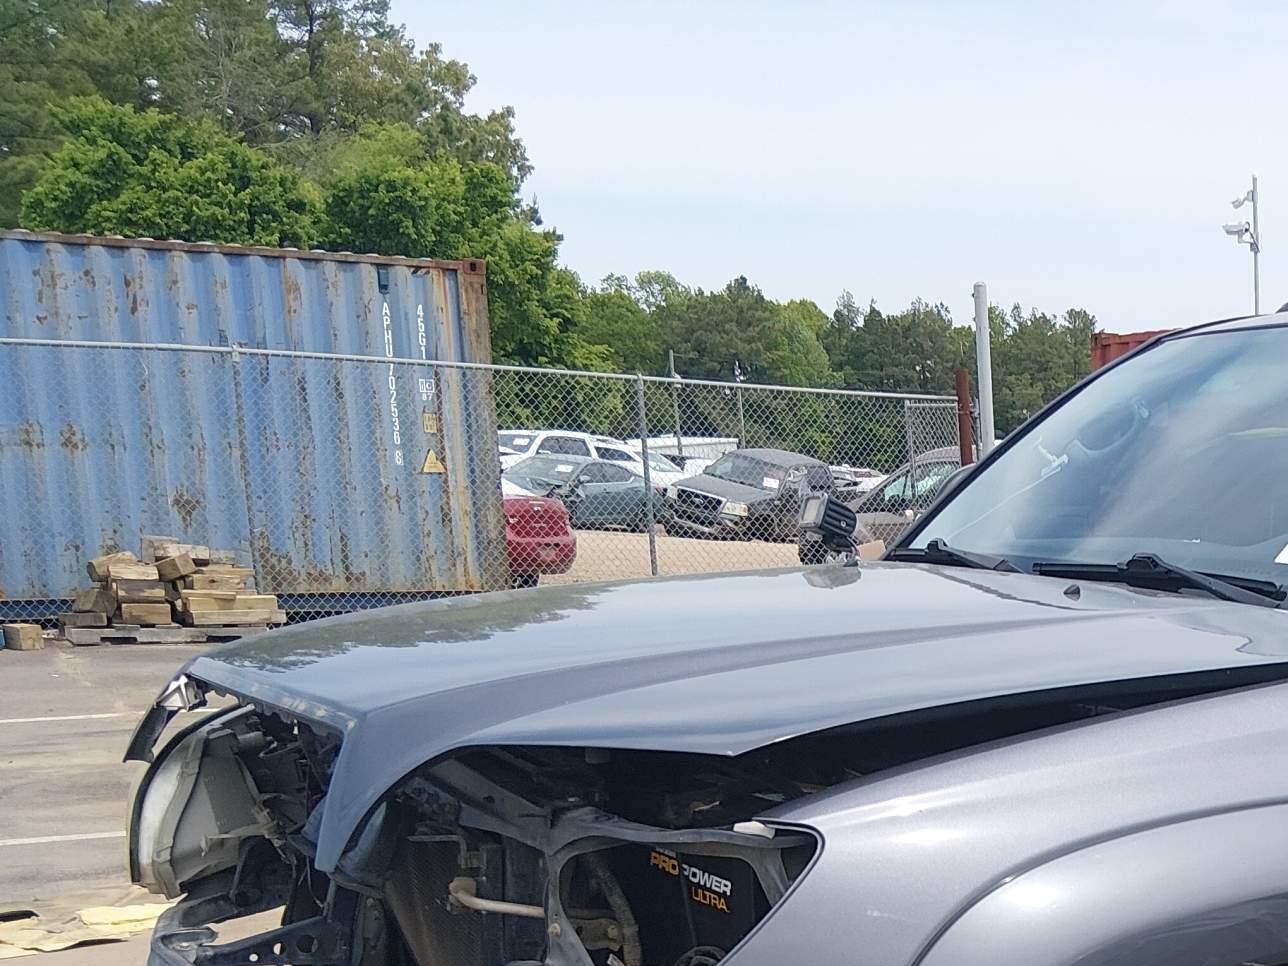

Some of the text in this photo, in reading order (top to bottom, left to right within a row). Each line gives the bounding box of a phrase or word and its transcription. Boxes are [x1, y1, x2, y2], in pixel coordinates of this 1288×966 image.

[382, 302, 394, 358] APHU
[416, 303, 427, 361] 45G1
[650, 851, 732, 896] PRO POWER
[692, 886, 729, 913] ULTRA
